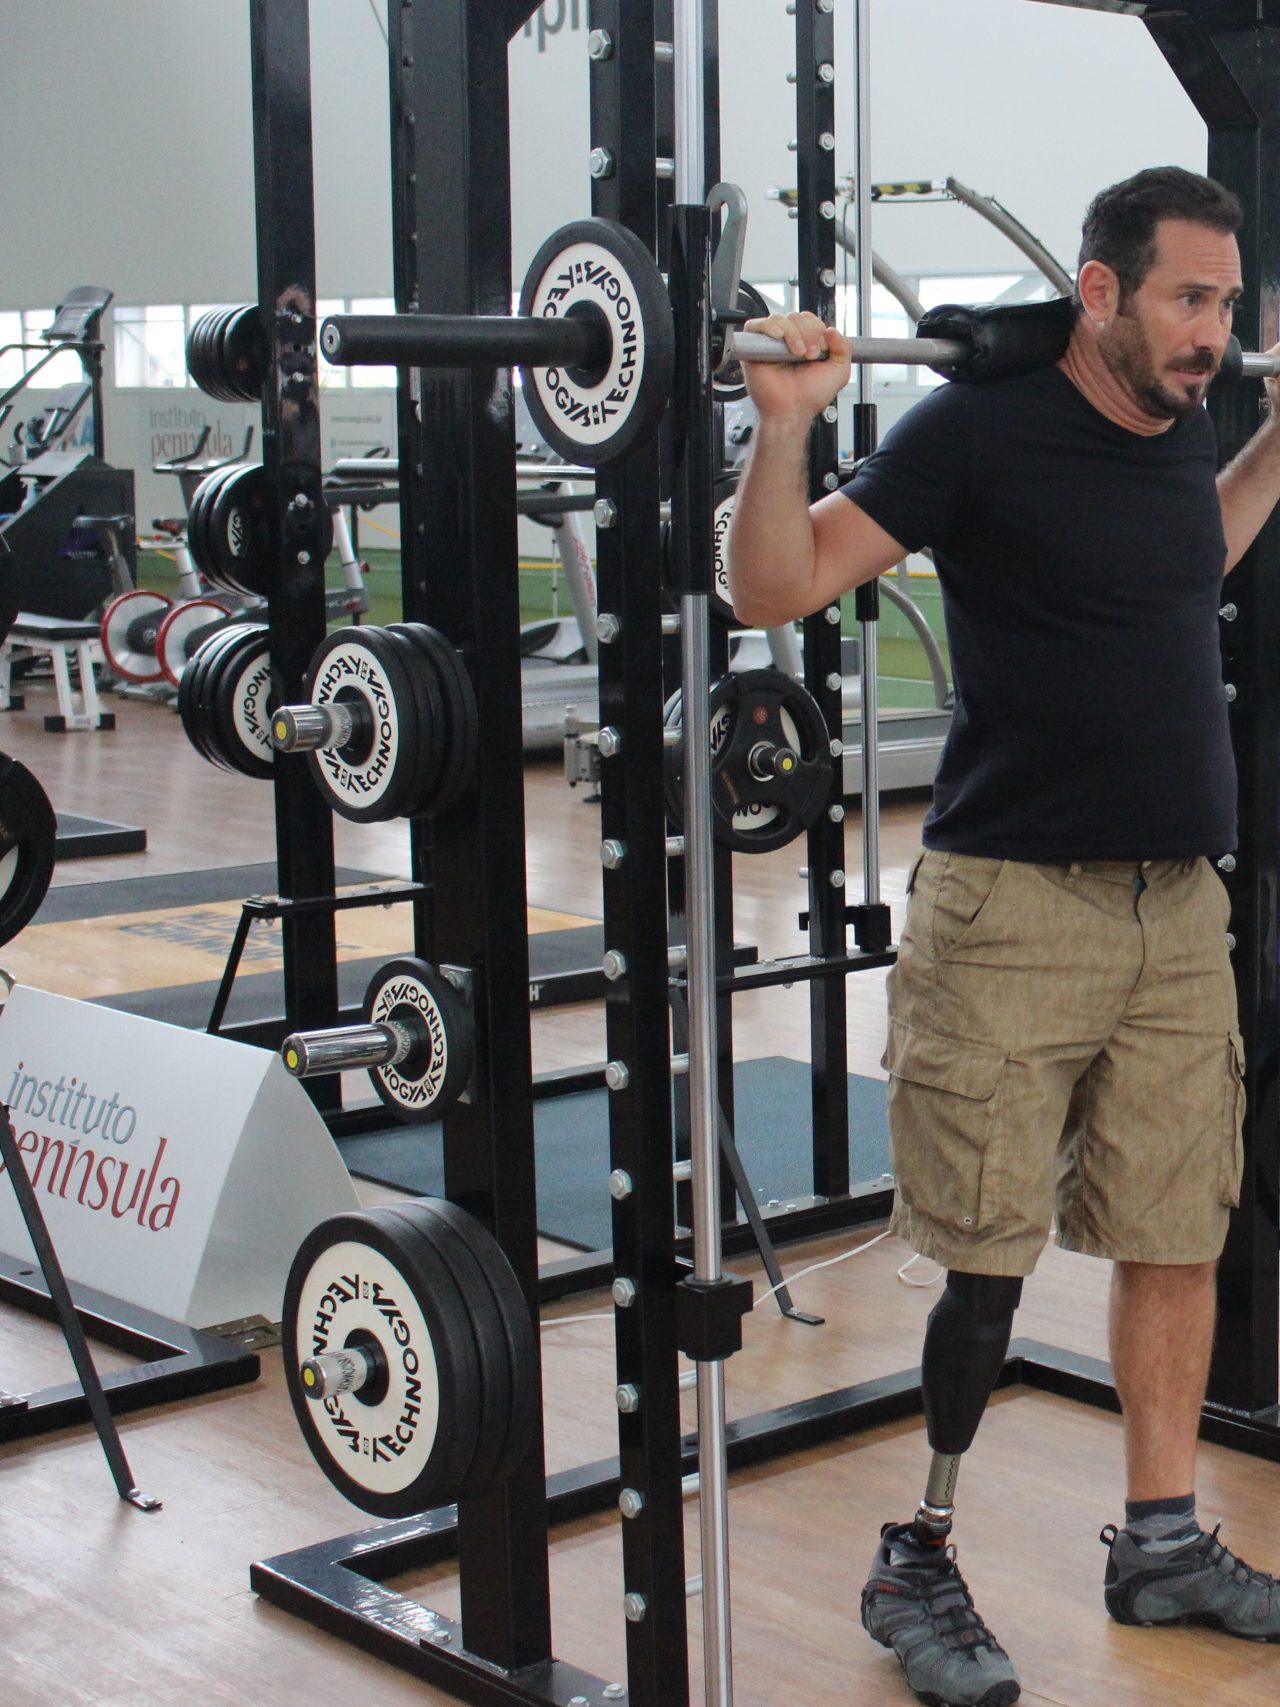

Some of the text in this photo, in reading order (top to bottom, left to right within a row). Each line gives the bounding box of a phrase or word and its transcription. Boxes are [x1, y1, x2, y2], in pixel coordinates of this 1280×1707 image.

[543, 264, 591, 428] TECOGYM
[584, 260, 637, 424] TECHNOGYM
[318, 655, 362, 780] TECHNYM
[347, 668, 392, 794] TECHNOGYM
[375, 997, 428, 1103] TENOGYM
[391, 983, 444, 1091] TECHNOGYM
[7, 1061, 137, 1145] instituto
[313, 1274, 360, 1454] TECHNGYM
[372, 1282, 422, 1463] TECHNOGYM
